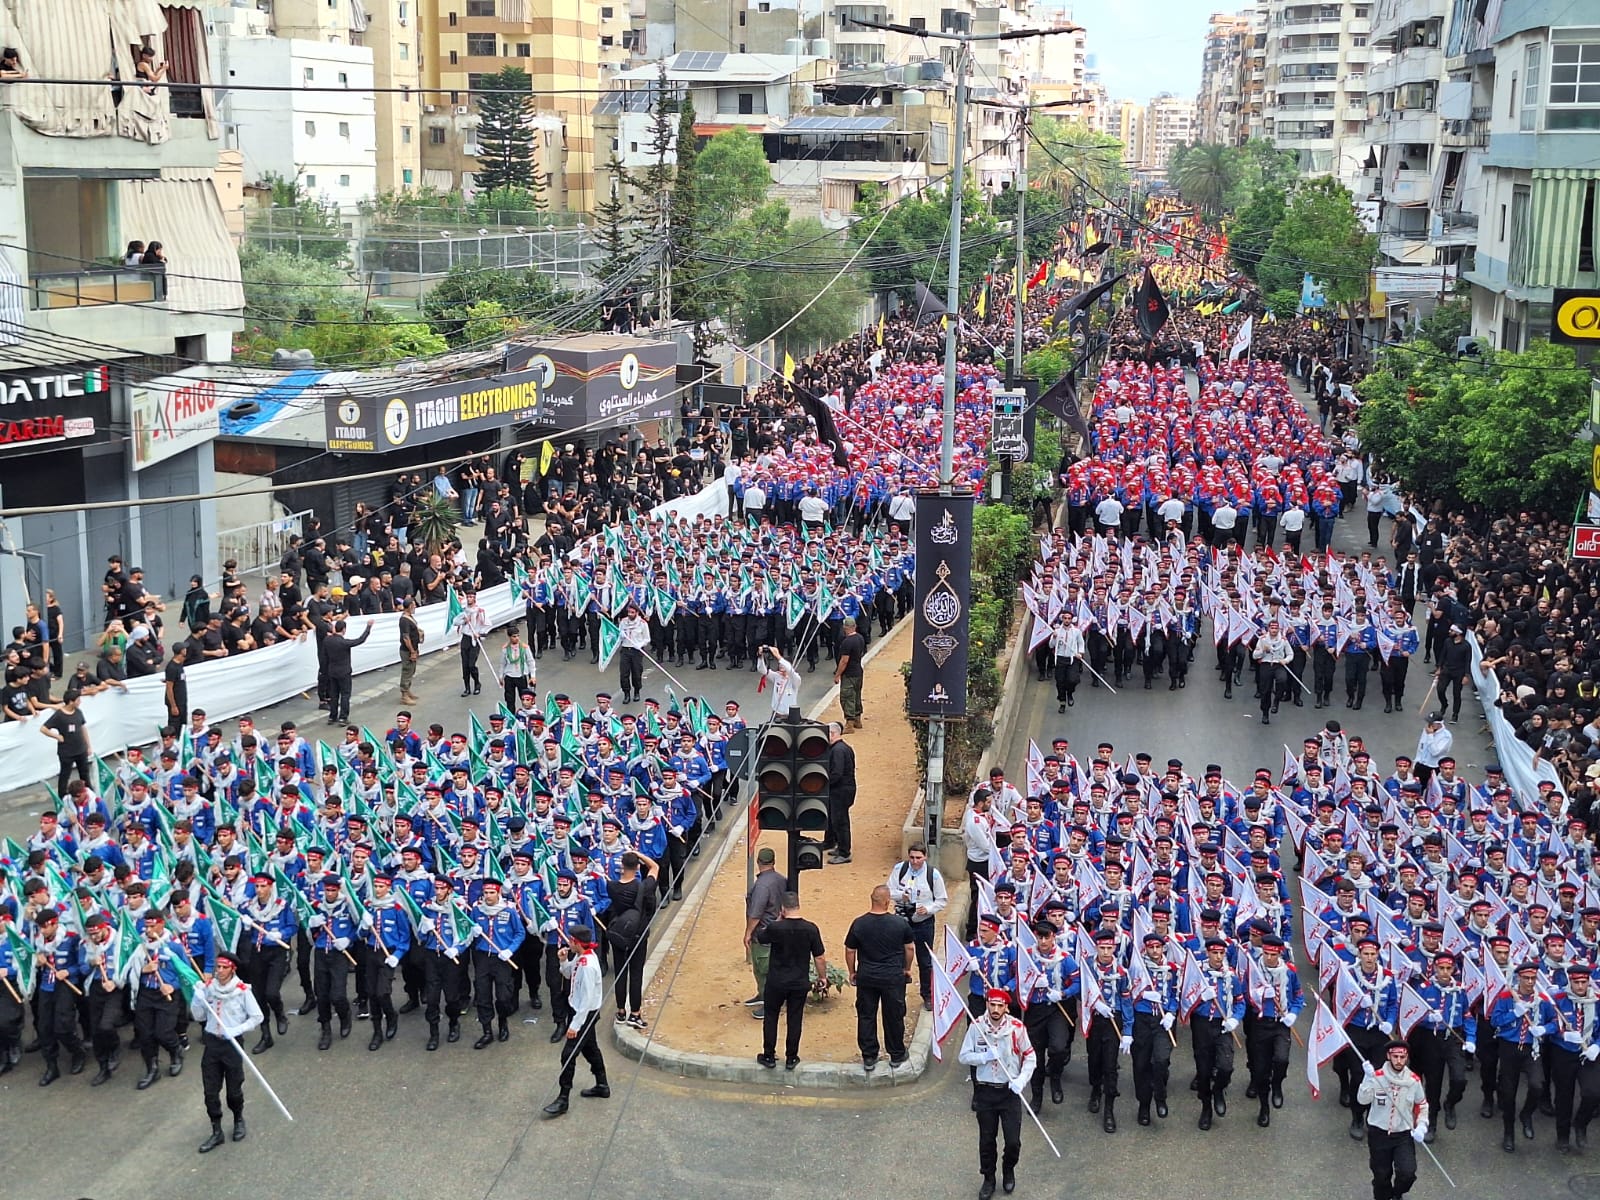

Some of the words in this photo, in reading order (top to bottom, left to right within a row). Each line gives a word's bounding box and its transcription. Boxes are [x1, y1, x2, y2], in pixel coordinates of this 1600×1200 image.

[174, 381, 216, 422] FRIGO
[415, 396, 459, 430] ITAOUI
[460, 380, 537, 421] ELECTRONICS
[1577, 540, 1597, 551] alfa
